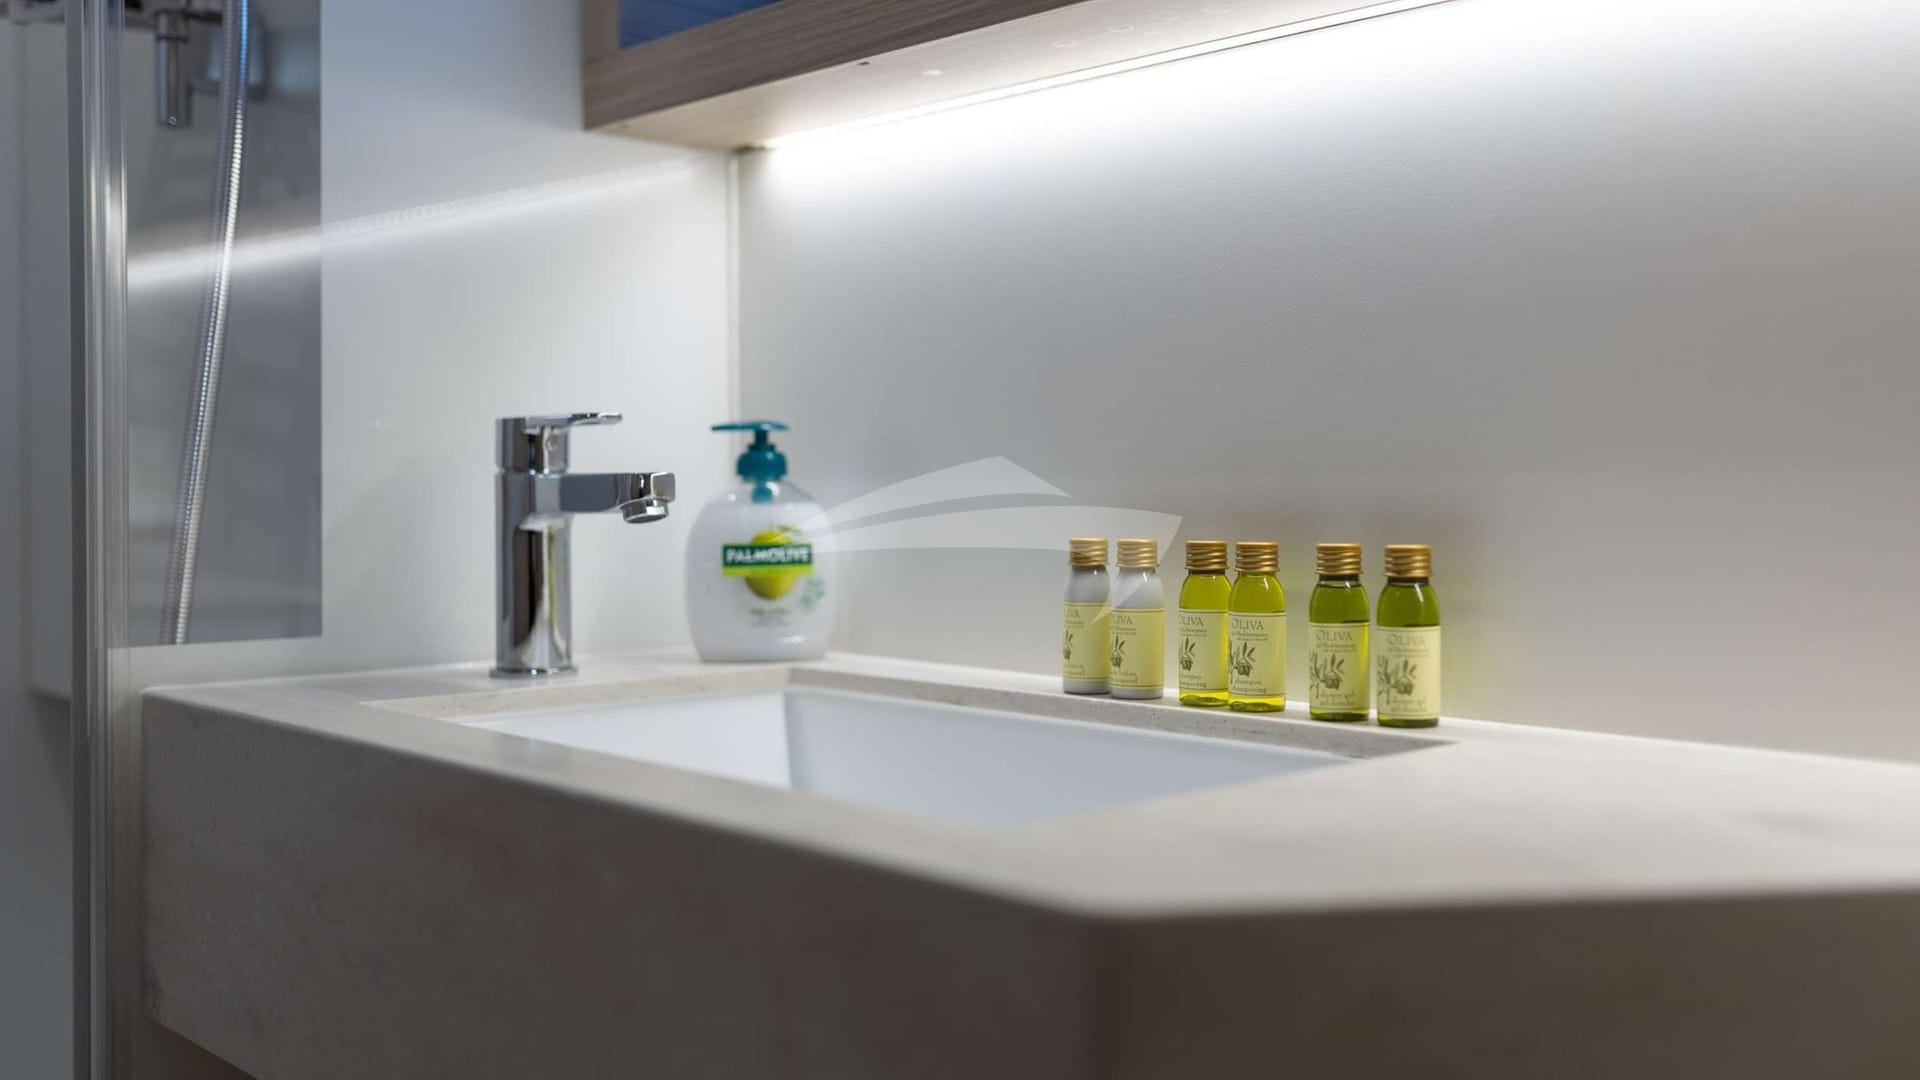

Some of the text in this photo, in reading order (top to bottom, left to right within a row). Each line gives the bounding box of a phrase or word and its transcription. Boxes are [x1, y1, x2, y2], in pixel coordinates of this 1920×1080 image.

[726, 547, 809, 564] PALMOLIVE
[1064, 608, 1081, 618] LIVA
[1110, 615, 1133, 625] LIVA
[1231, 618, 1264, 630] OLIVA
[1316, 629, 1353, 641] OLIVA
[1387, 633, 1425, 646] OLIVA
